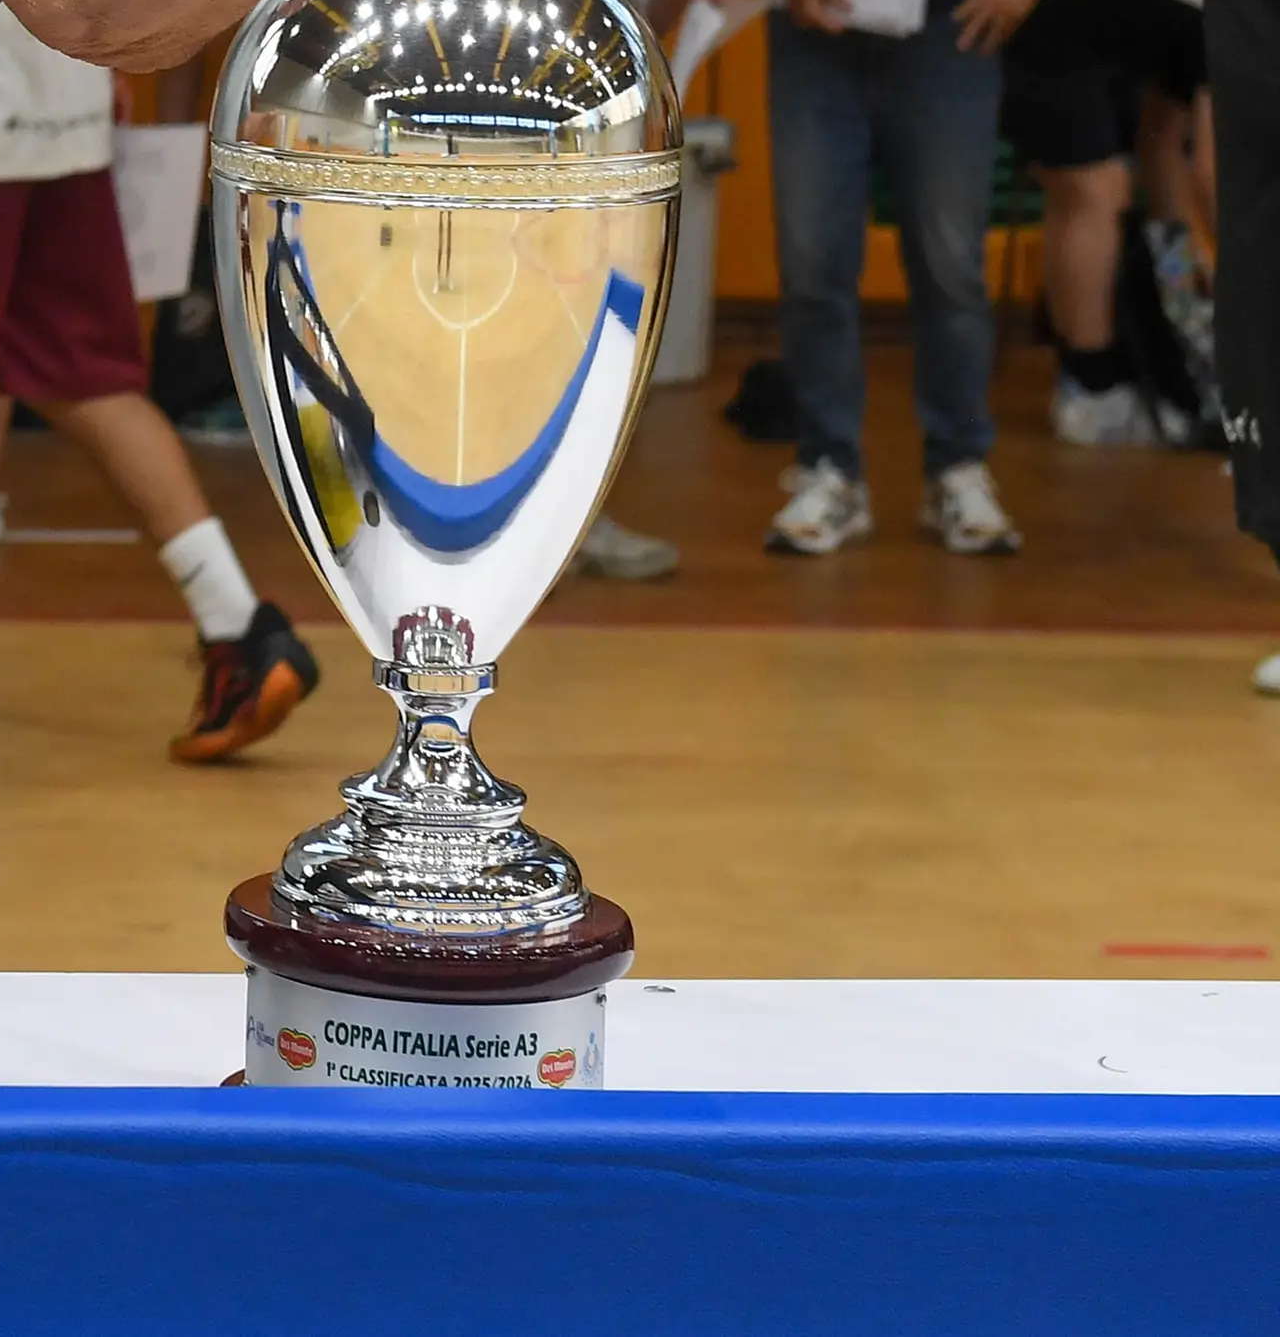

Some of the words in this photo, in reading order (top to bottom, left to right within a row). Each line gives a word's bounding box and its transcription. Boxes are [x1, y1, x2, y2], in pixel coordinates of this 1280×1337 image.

[323, 1019, 388, 1052] COPPA
[392, 1028, 462, 1058] ITALIA
[465, 1034, 510, 1059] Serie
[513, 1031, 538, 1057] A3
[340, 1064, 449, 1088] CLASSIFICATA
